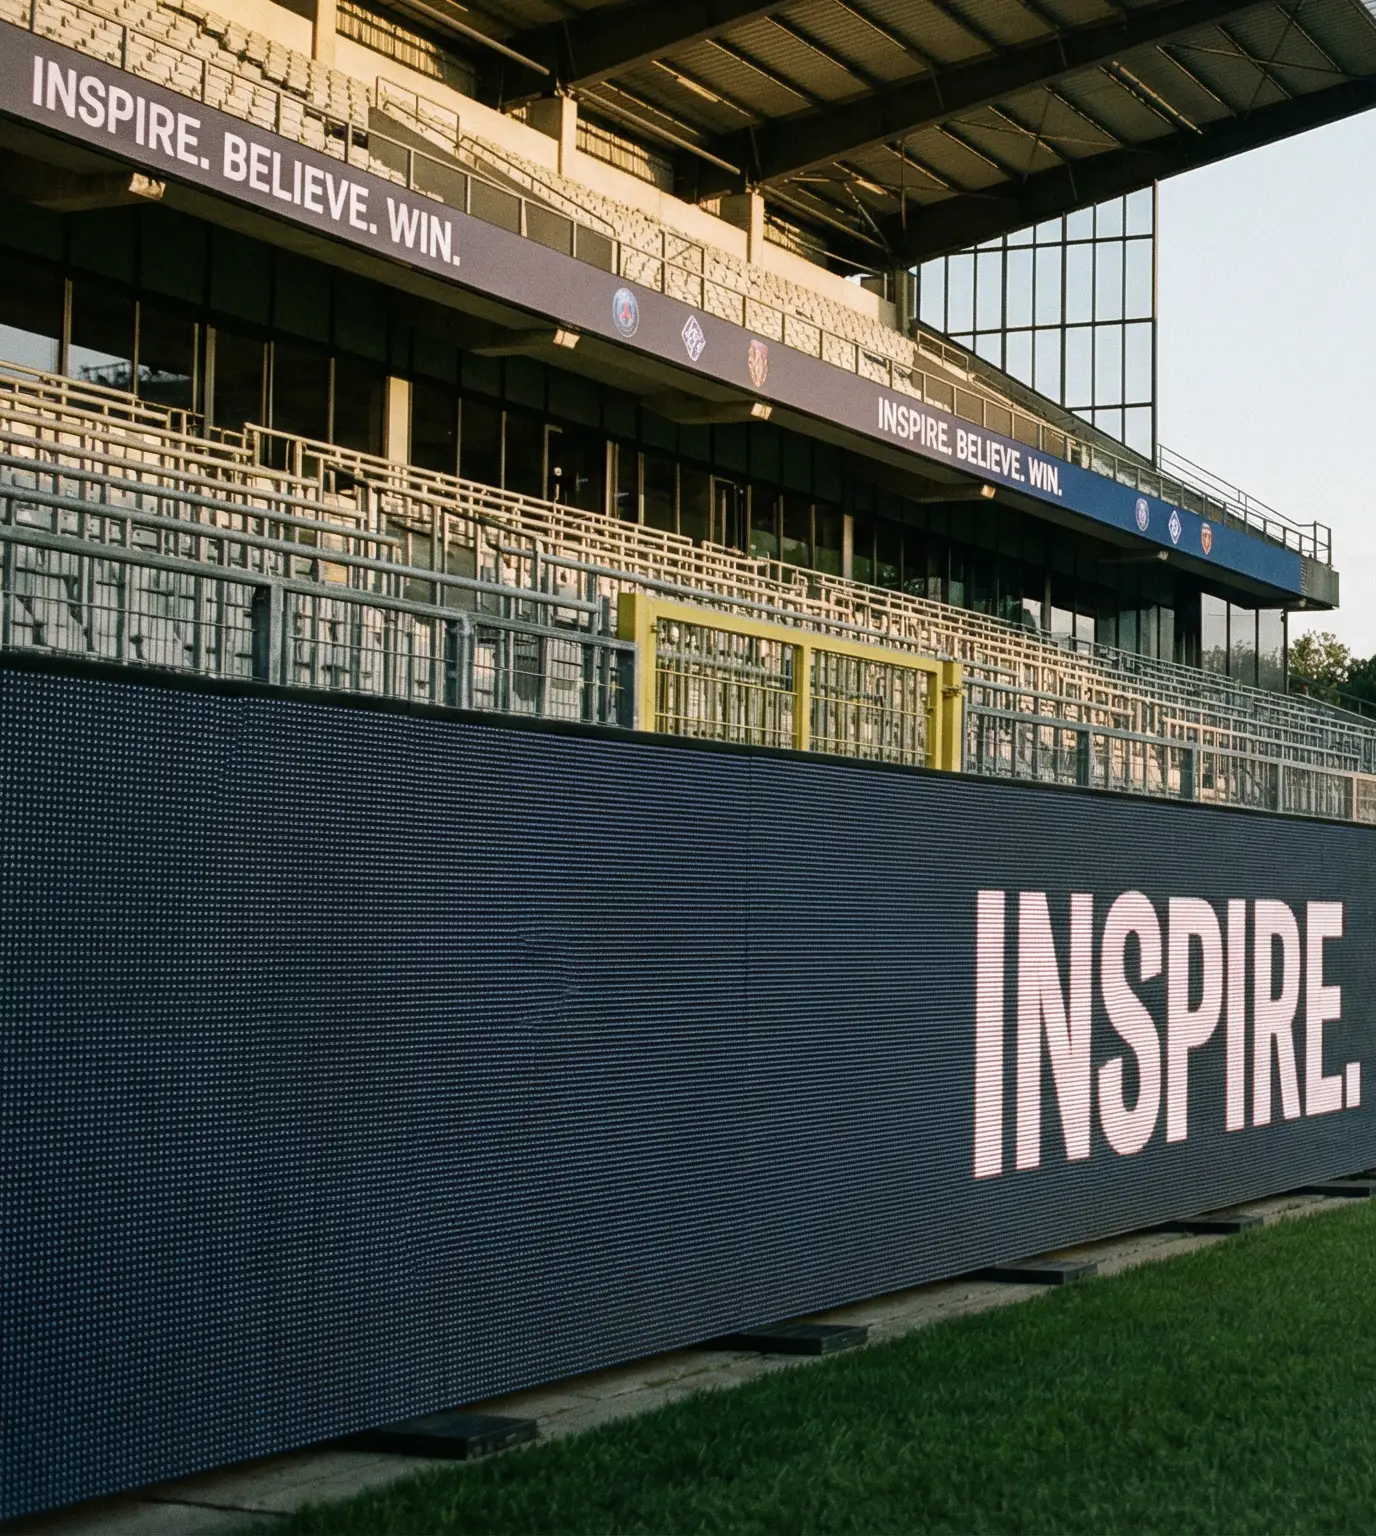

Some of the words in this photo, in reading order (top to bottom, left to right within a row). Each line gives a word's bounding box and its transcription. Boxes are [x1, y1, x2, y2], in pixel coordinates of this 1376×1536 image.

[32, 55, 210, 170] INSPIRE.
[223, 131, 378, 235] BELIEVE.
[387, 197, 461, 267] WIN.
[878, 397, 953, 456] INSPIRE.
[956, 428, 1025, 482] BELIEVE.
[1028, 456, 1063, 497] WIN.
[973, 890, 1362, 1179] INSPIRE.
